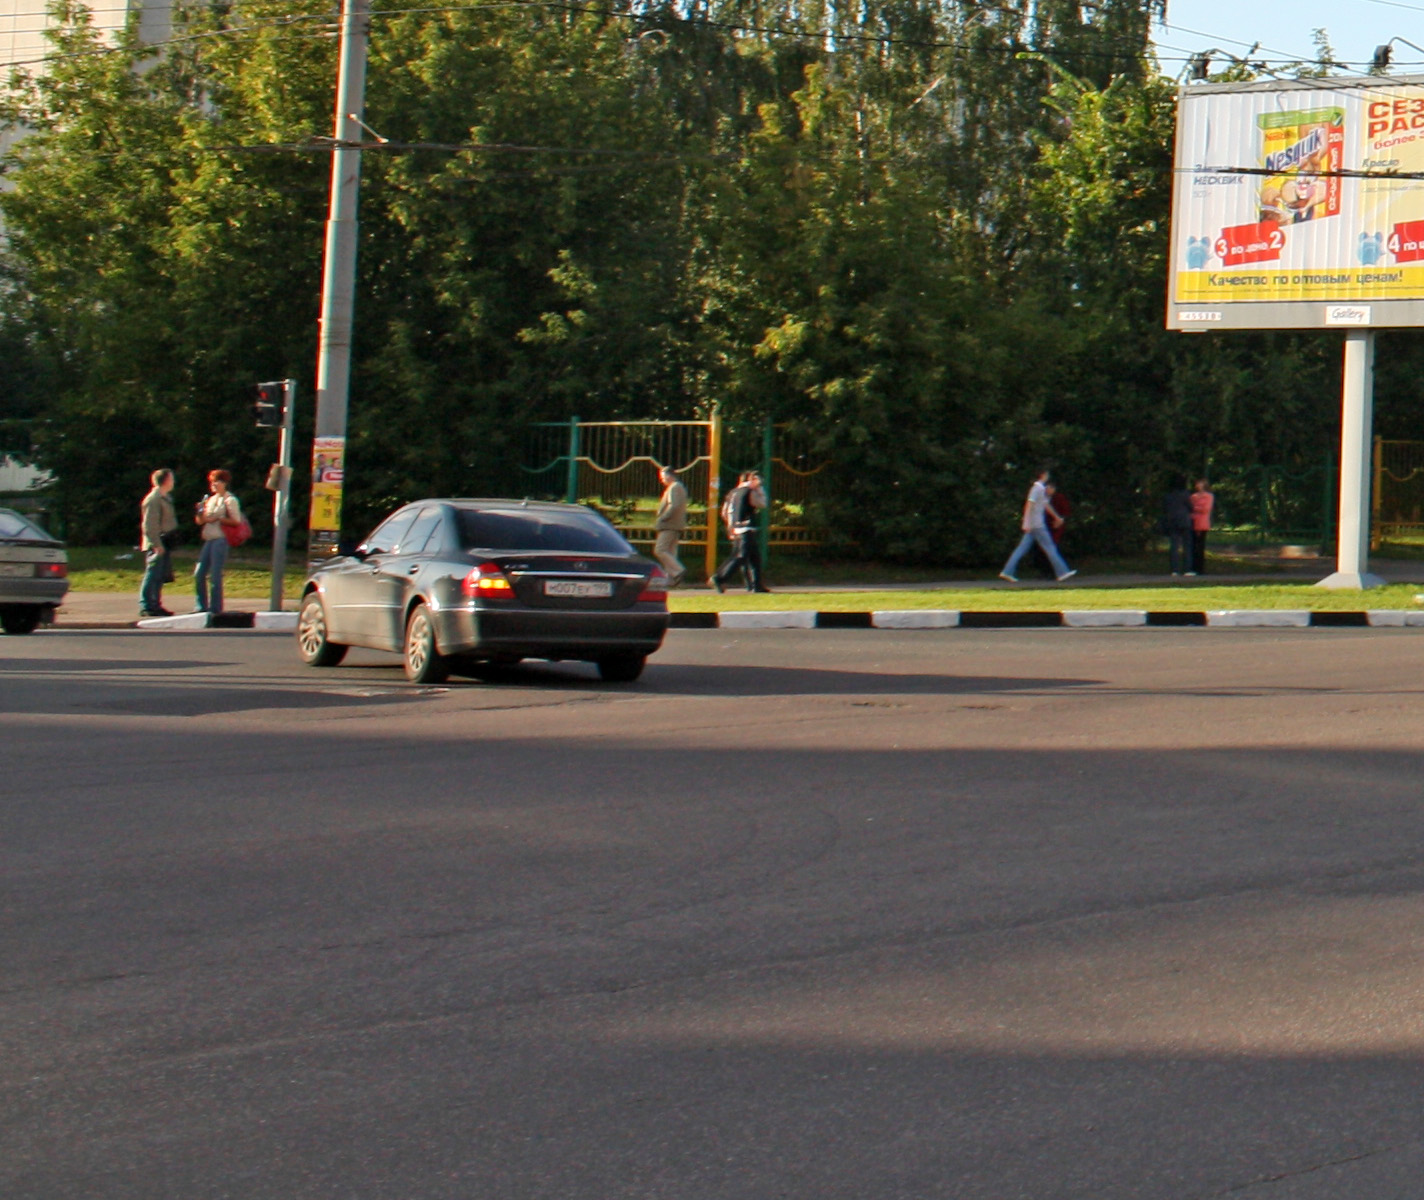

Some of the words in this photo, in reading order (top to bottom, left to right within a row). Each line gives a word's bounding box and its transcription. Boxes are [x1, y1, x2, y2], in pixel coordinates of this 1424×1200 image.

[1373, 134, 1416, 151] более
[1216, 239, 1229, 257] 3
[1269, 231, 1282, 250] 2
[1387, 233, 1401, 253] 4
[1403, 241, 1418, 251] по
[1207, 274, 1268, 287] Качество
[1272, 275, 1289, 285] по
[1292, 273, 1351, 286] оптовым
[1355, 269, 1403, 286] ценам!
